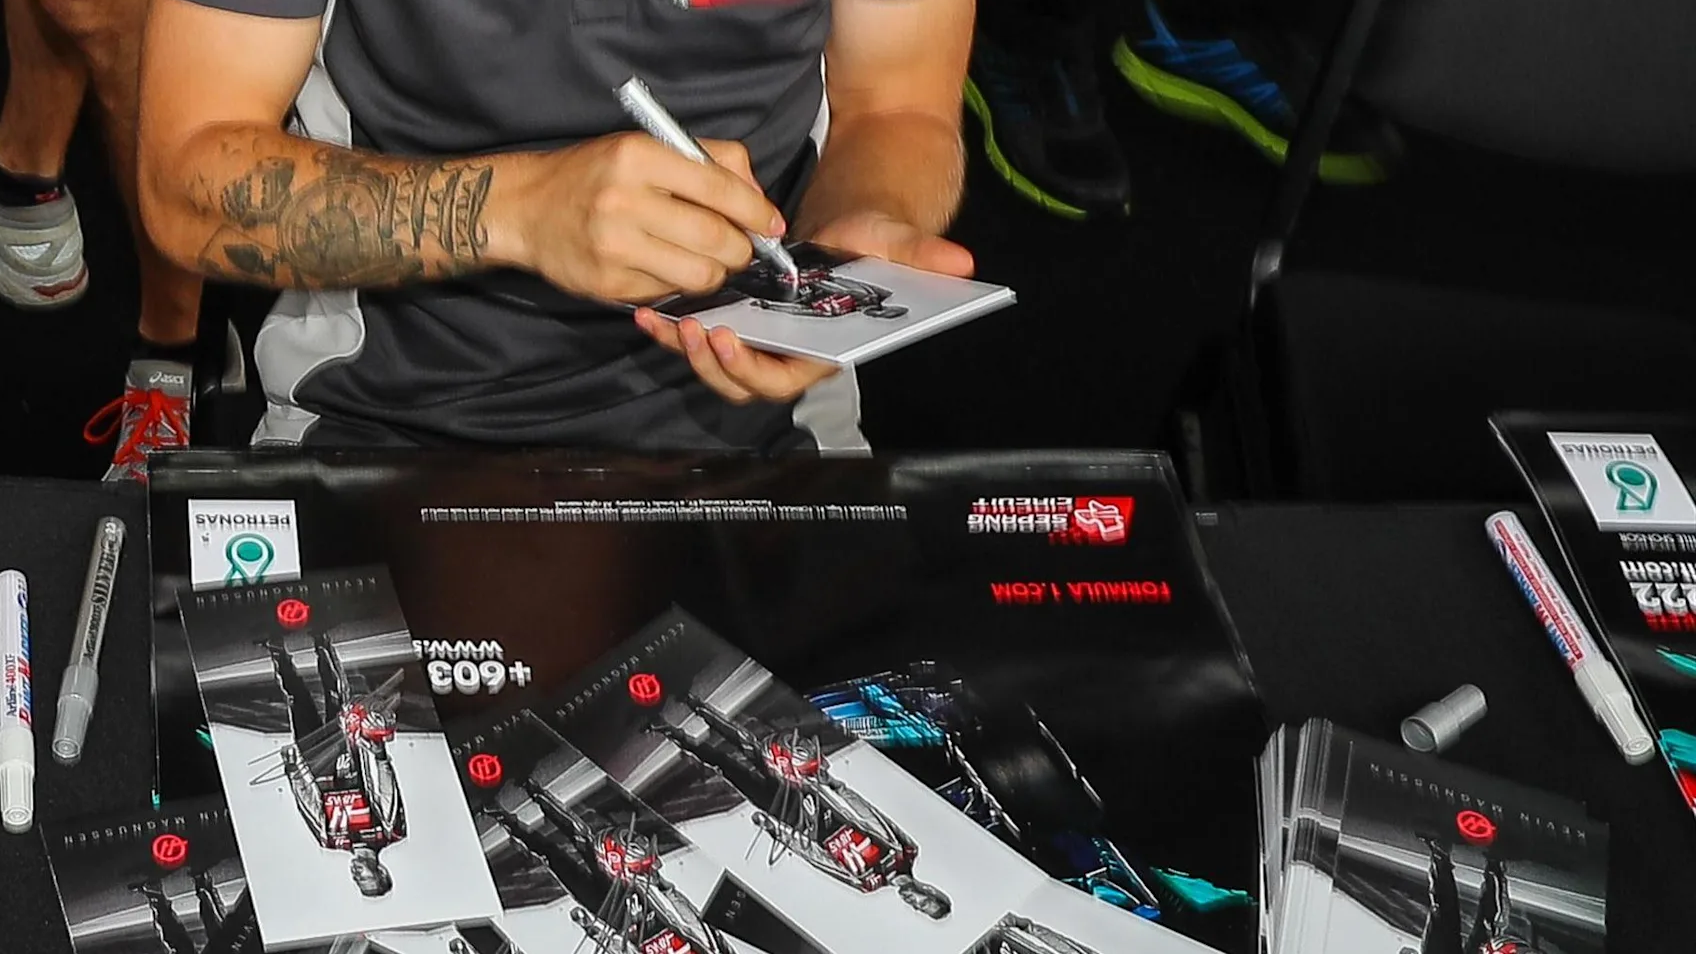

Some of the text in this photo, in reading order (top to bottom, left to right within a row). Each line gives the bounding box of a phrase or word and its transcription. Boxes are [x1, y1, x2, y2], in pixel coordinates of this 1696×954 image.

[194, 511, 291, 528] PETRONAS
[1066, 581, 1171, 603] FORMULA
[427, 660, 532, 695] +603
[1369, 761, 1588, 842] KEVIN MAGNUSSEN
